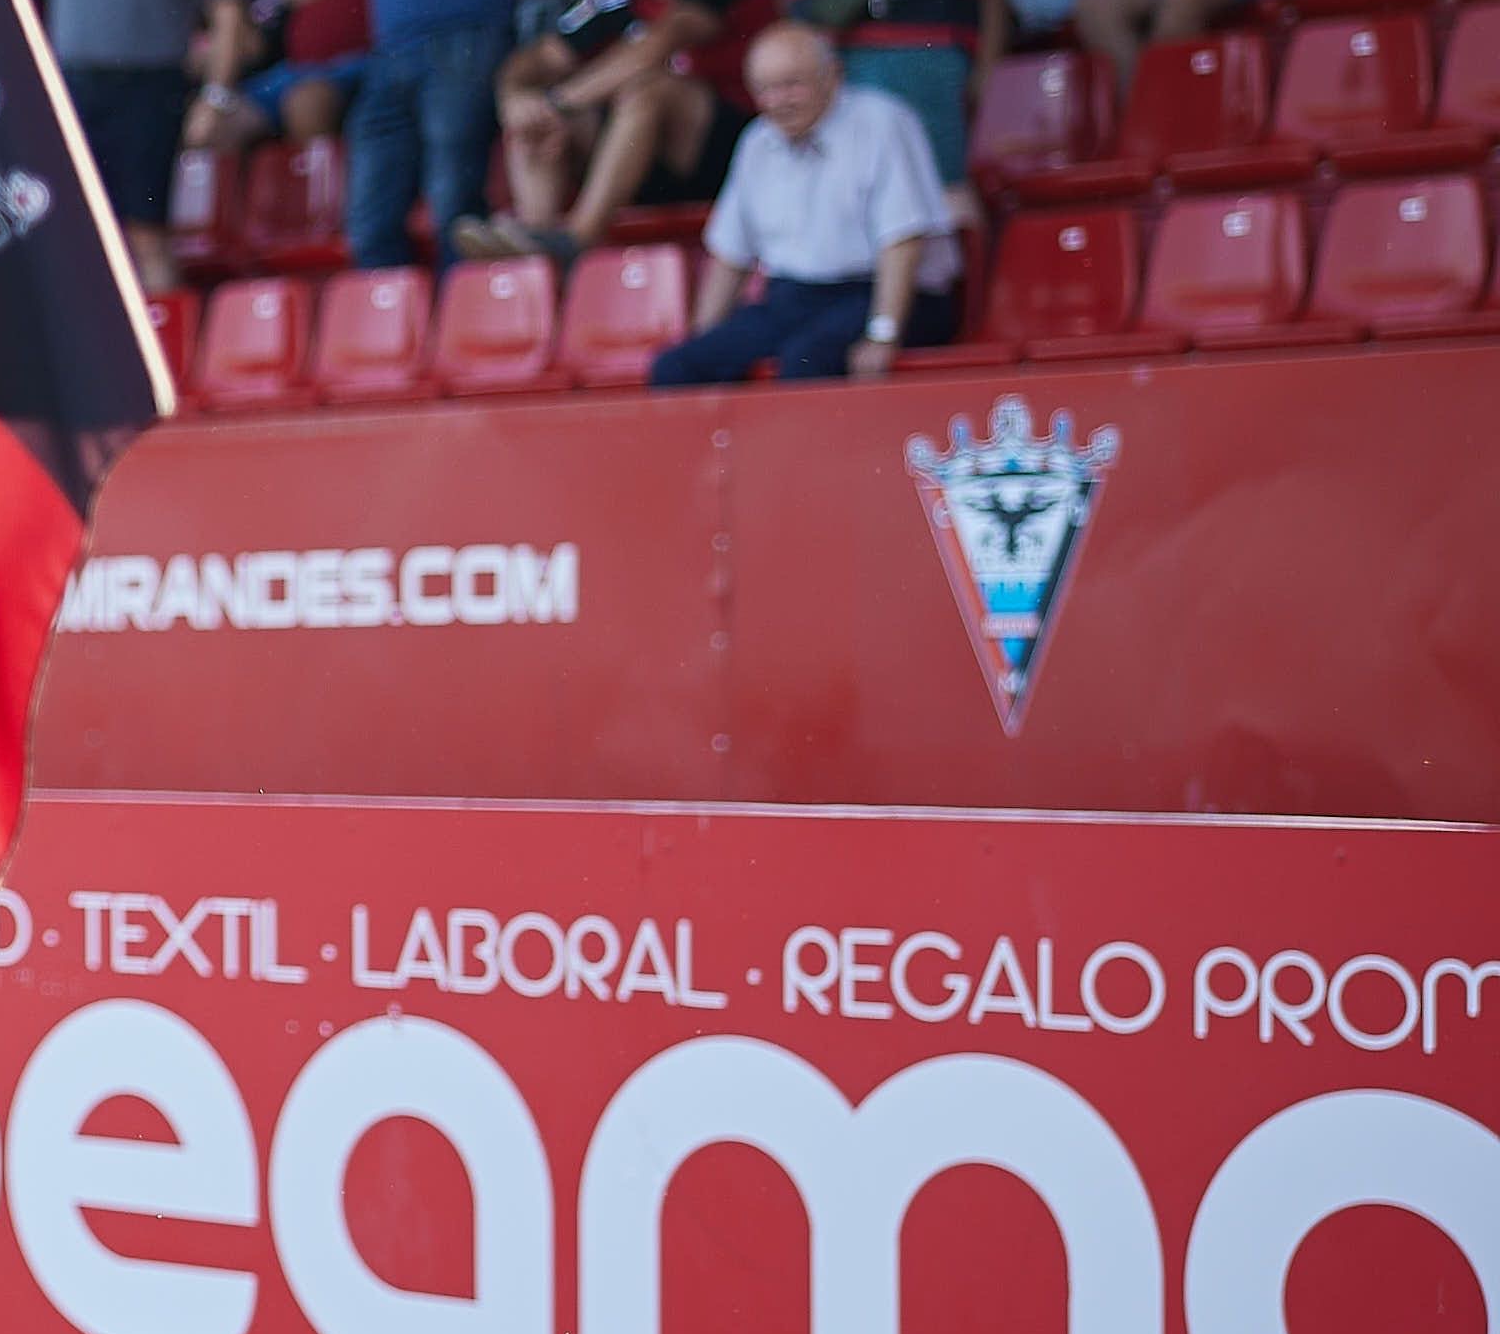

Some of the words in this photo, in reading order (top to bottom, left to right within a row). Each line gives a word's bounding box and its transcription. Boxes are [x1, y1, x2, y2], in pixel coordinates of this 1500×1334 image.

[70, 890, 308, 985] TEXTIL
[351, 903, 728, 1011] LABORAL
[782, 923, 1167, 1036] REGALO
